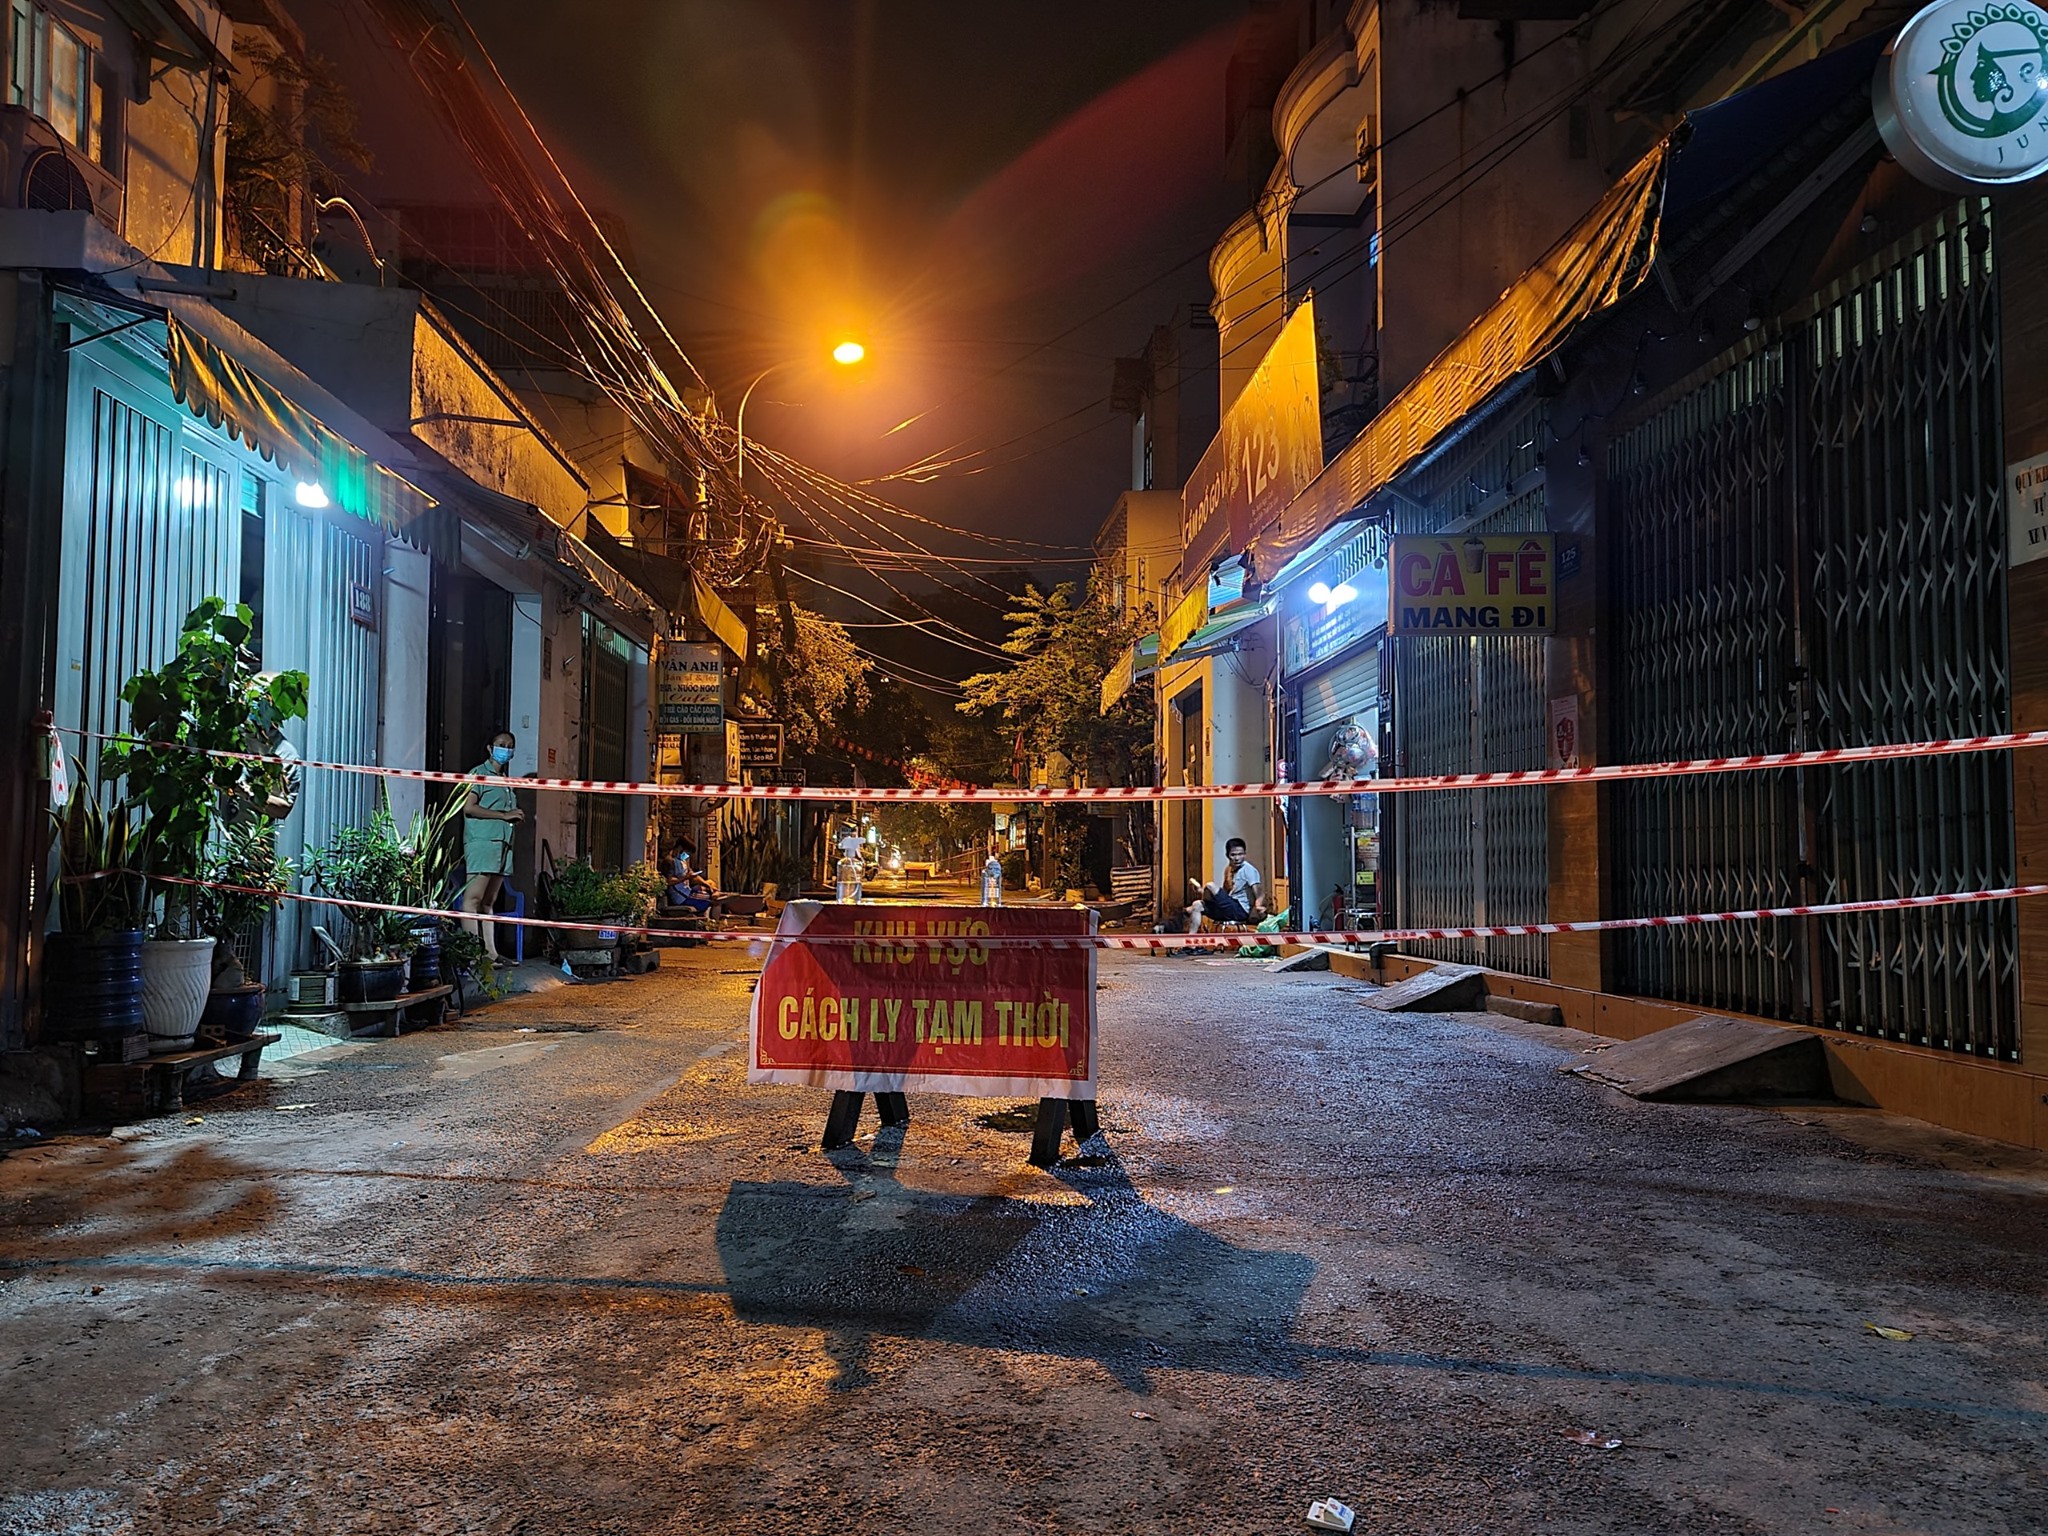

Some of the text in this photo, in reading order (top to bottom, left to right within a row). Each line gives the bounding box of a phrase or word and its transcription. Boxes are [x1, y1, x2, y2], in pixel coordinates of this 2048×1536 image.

[1241, 417, 1280, 505] 123
[1400, 540, 1547, 597] CÀ FÊ
[1561, 546, 1577, 565] 125
[354, 588, 371, 613] 188
[1403, 605, 1547, 630] MANG ĐI
[660, 658, 719, 671] VÂN ANH
[852, 916, 990, 975] KHU VỰC
[778, 987, 1070, 1055] CÁCH LY TẠM THỜI
